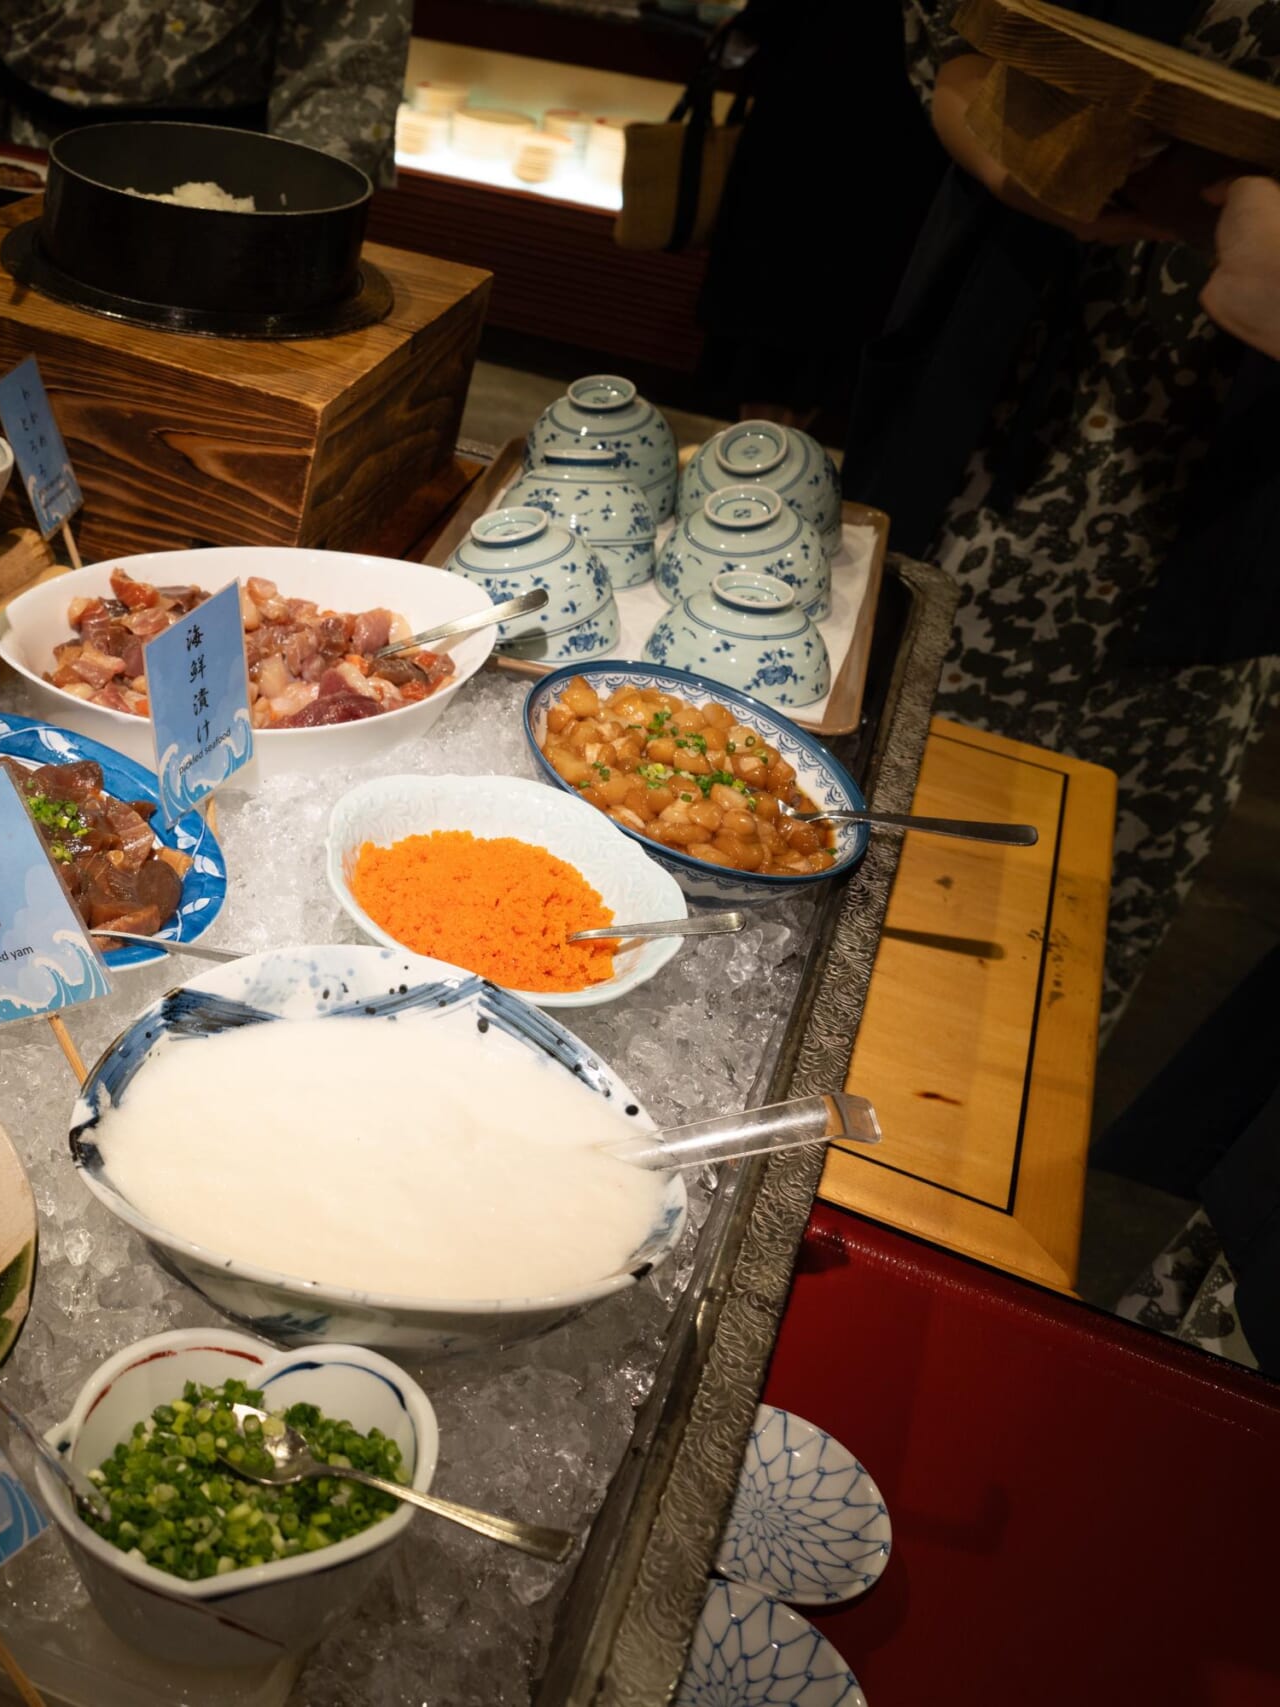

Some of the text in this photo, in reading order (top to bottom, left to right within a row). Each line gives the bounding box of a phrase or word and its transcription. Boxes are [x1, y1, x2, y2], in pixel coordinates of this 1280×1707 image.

[186, 624, 210, 743] 海鮮漬け
[179, 727, 231, 776] pickled seafood
[10, 946, 34, 960] yam
